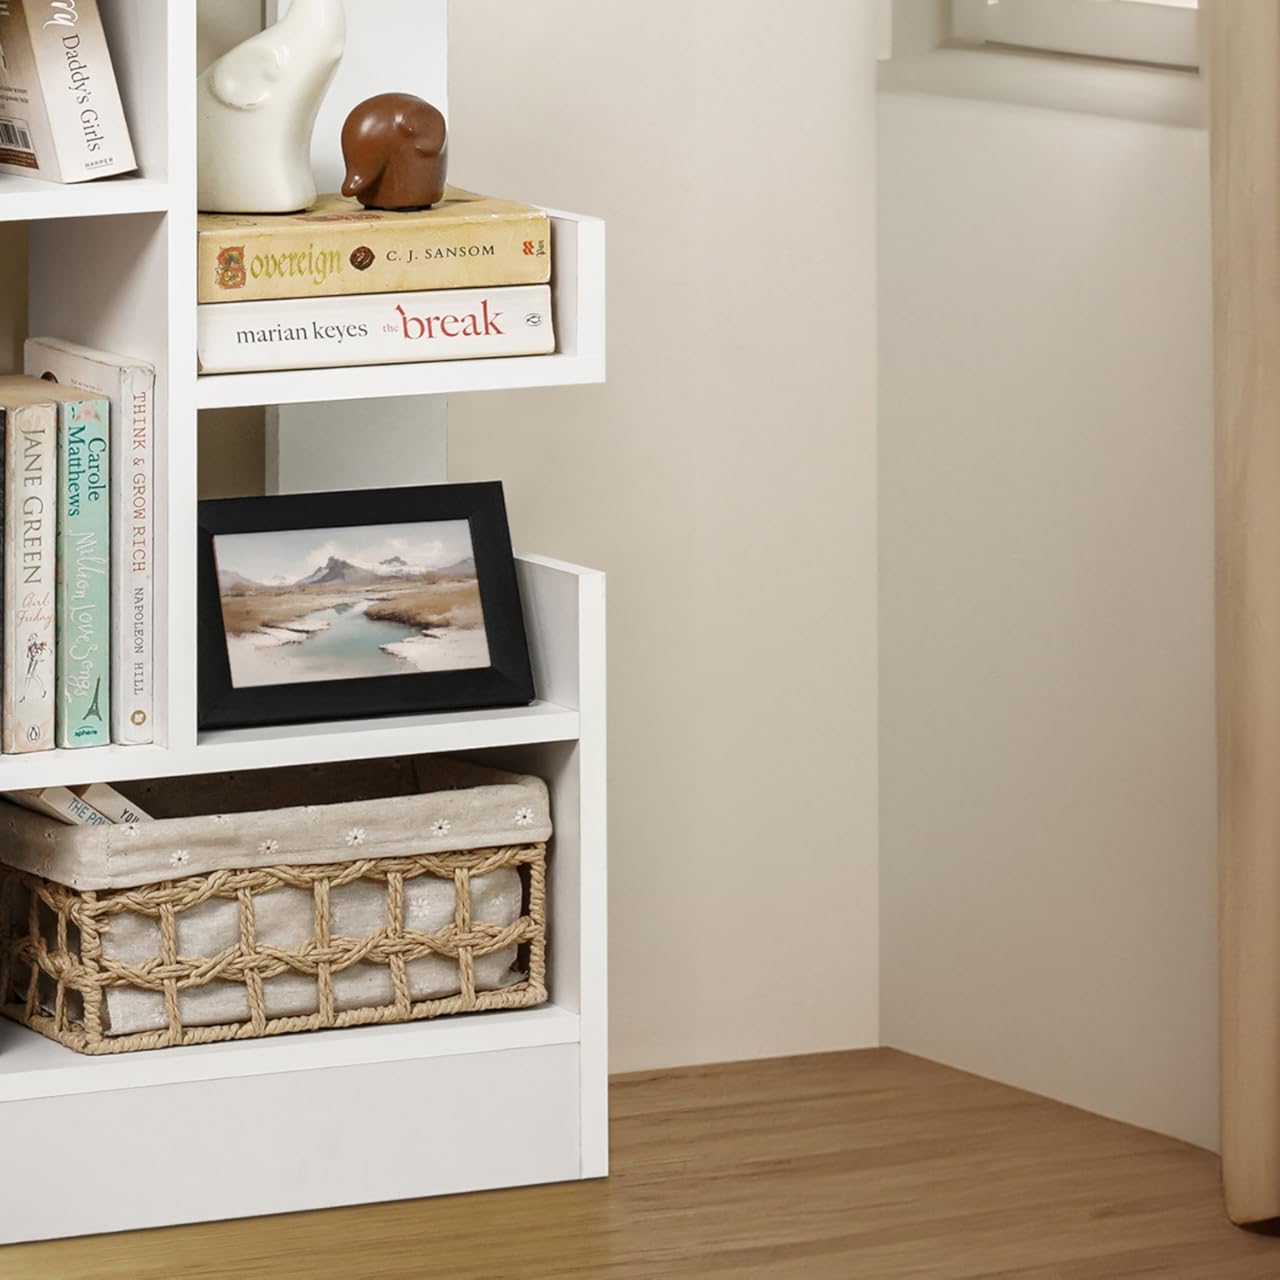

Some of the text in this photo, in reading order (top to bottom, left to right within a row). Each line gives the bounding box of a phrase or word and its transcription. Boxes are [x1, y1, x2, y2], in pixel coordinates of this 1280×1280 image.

[62, 34, 105, 152] Daddy's Girls
[84, 157, 114, 168] HARPER
[386, 250, 402, 262] C.
[407, 250, 419, 263] J.
[424, 245, 496, 260] SANSOM
[236, 299, 505, 343] marian keyes the break
[21, 428, 45, 584] JANE GREEN
[68, 425, 86, 517] Matthews
[87, 437, 107, 502] Carole
[132, 391, 146, 572] THINK & GROW RICH
[67, 529, 106, 700] Million Love Songs
[134, 587, 145, 696] NAPOLEON HILL
[75, 729, 98, 738] sphere
[67, 797, 87, 819] THE
